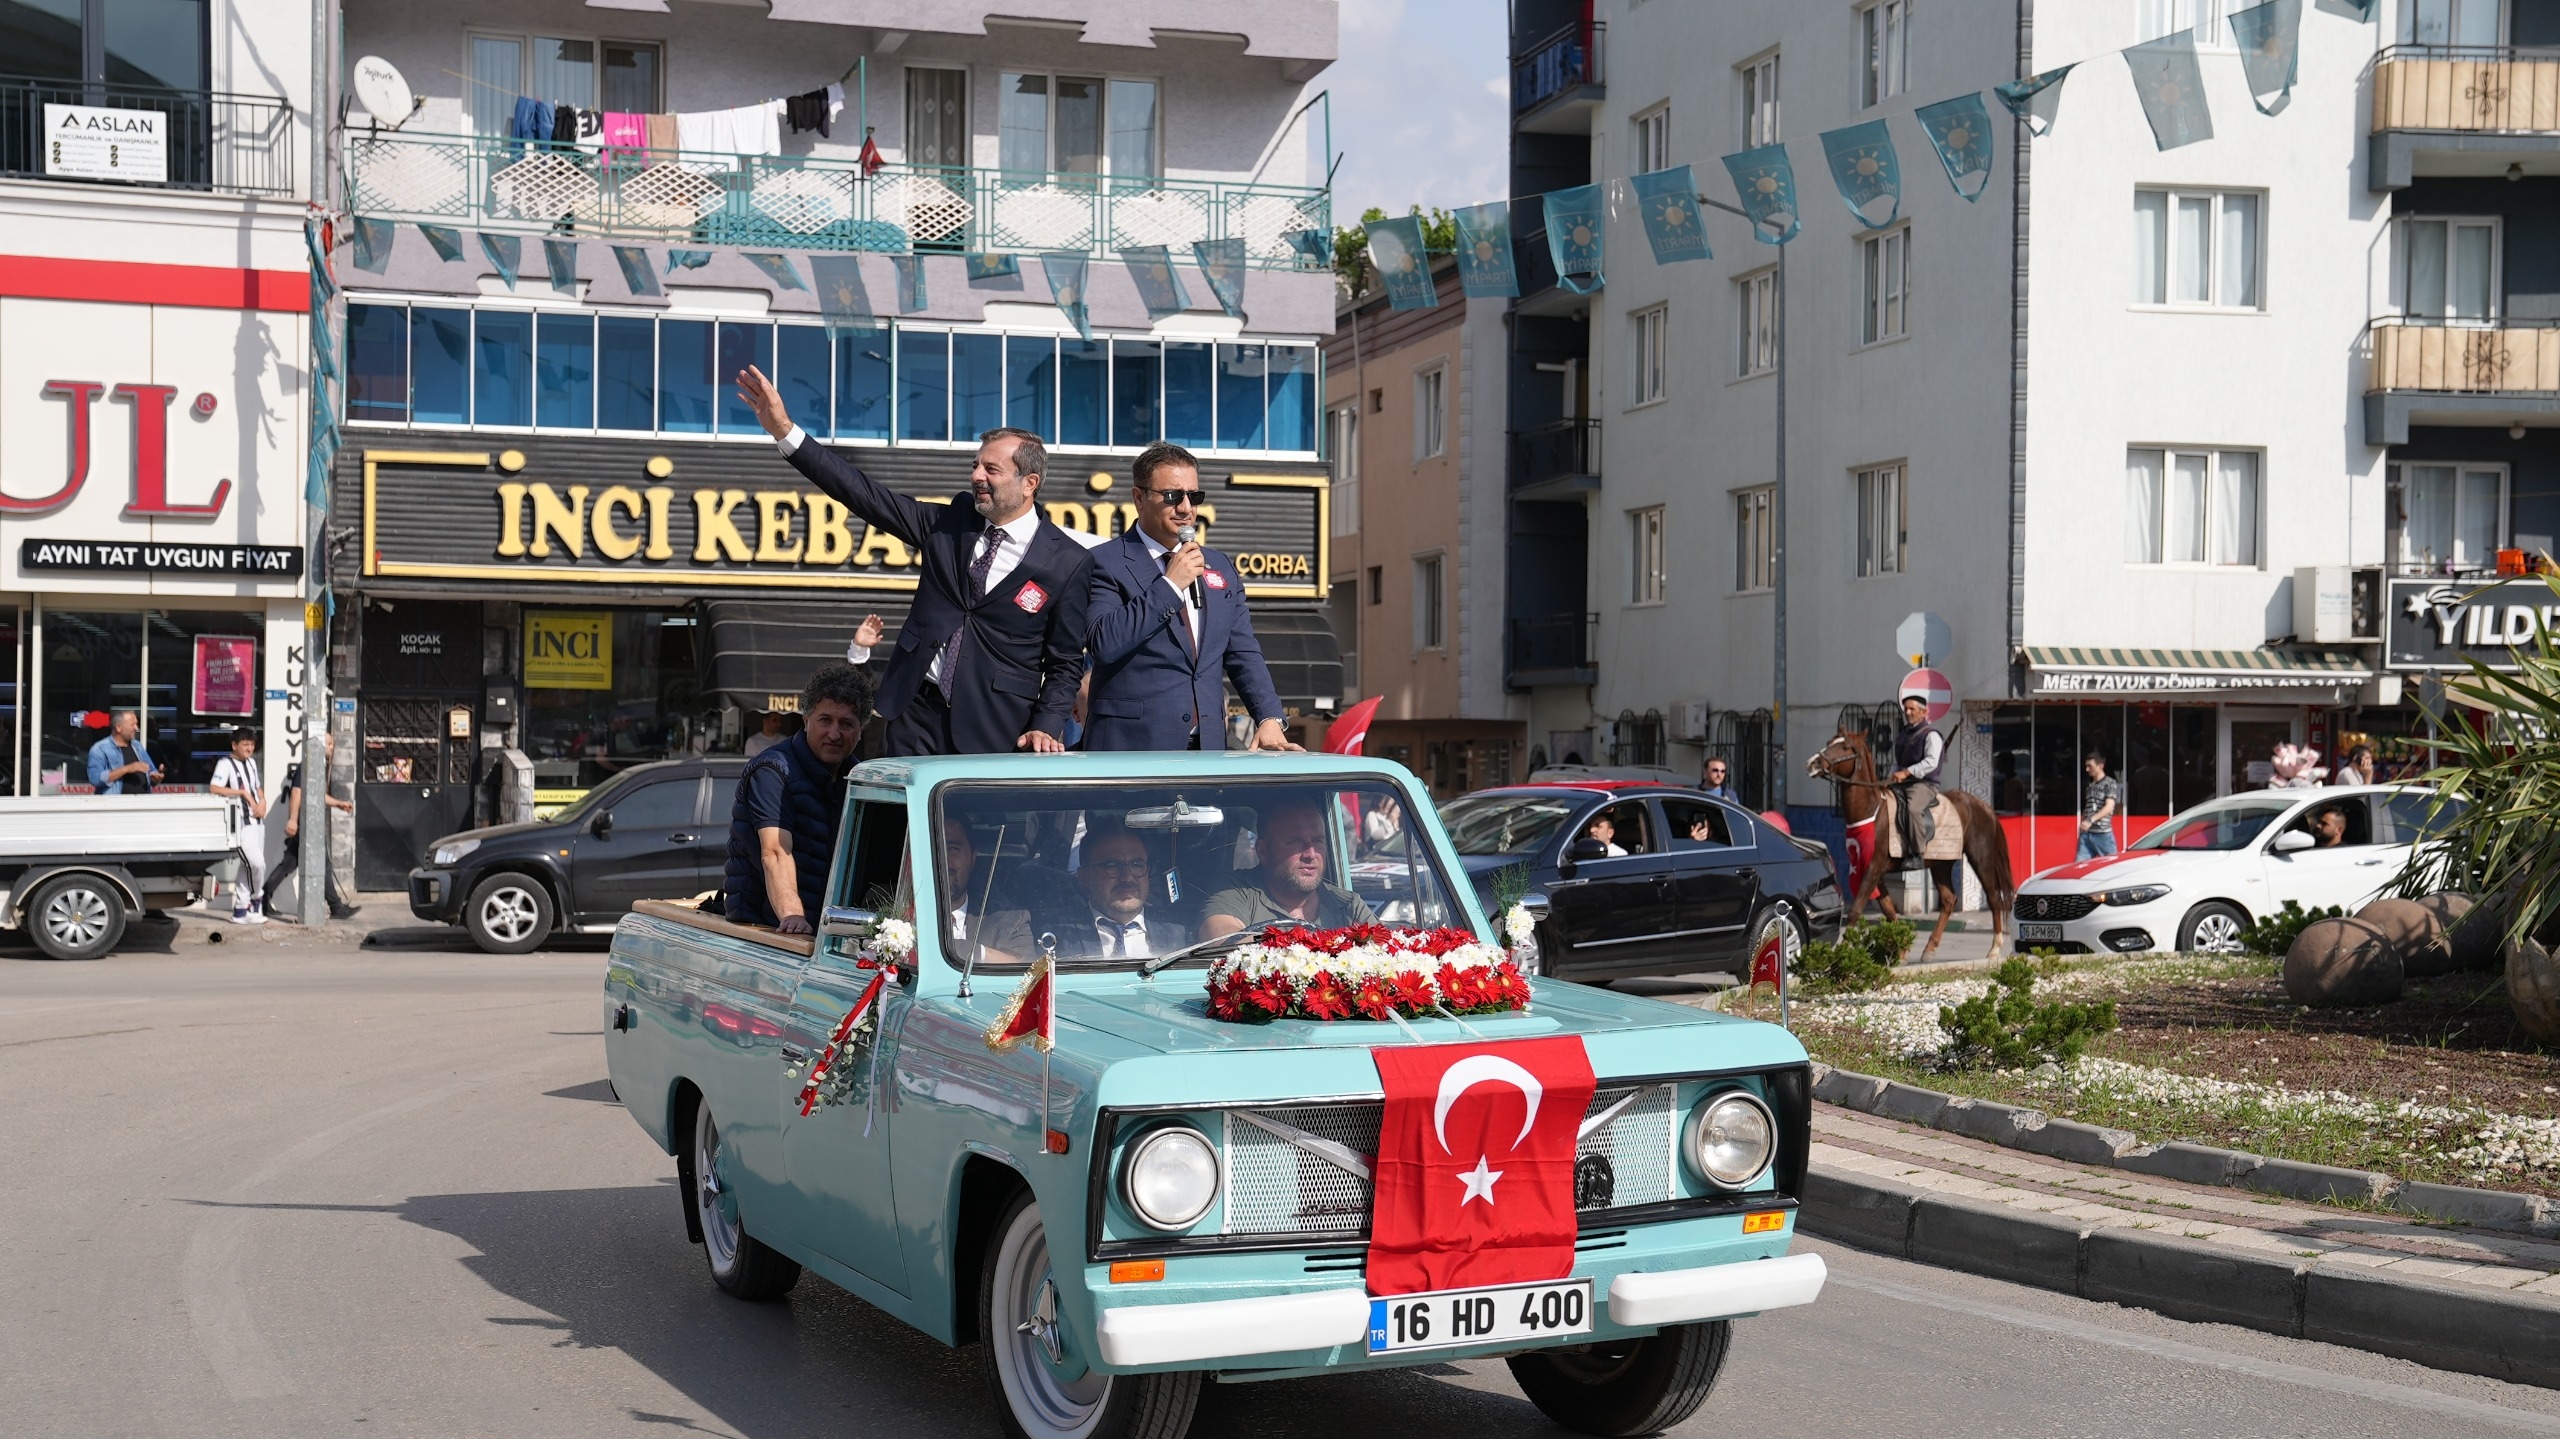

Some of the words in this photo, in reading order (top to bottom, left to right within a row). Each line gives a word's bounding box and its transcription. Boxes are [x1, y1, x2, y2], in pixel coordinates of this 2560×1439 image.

[86, 115, 153, 134] ASLAN
[497, 449, 675, 561] İNCİ
[692, 488, 952, 567] KEBA
[36, 544, 90, 565] AYNI
[95, 546, 139, 566] TAT
[144, 547, 224, 568] UYGUN
[231, 547, 292, 570] FİYAT
[1235, 552, 1310, 578] ÇORBA
[400, 633, 442, 647] KOÇAK
[531, 621, 600, 660] İNCİ
[2043, 673, 2090, 691] MERT
[2093, 674, 2151, 691] TAVUK
[2153, 672, 2218, 689] DÖNER
[1371, 1329, 1386, 1342] TR
[1393, 1302, 1430, 1343] 16
[1452, 1297, 1495, 1337] HD
[1519, 1288, 1584, 1331] 400
